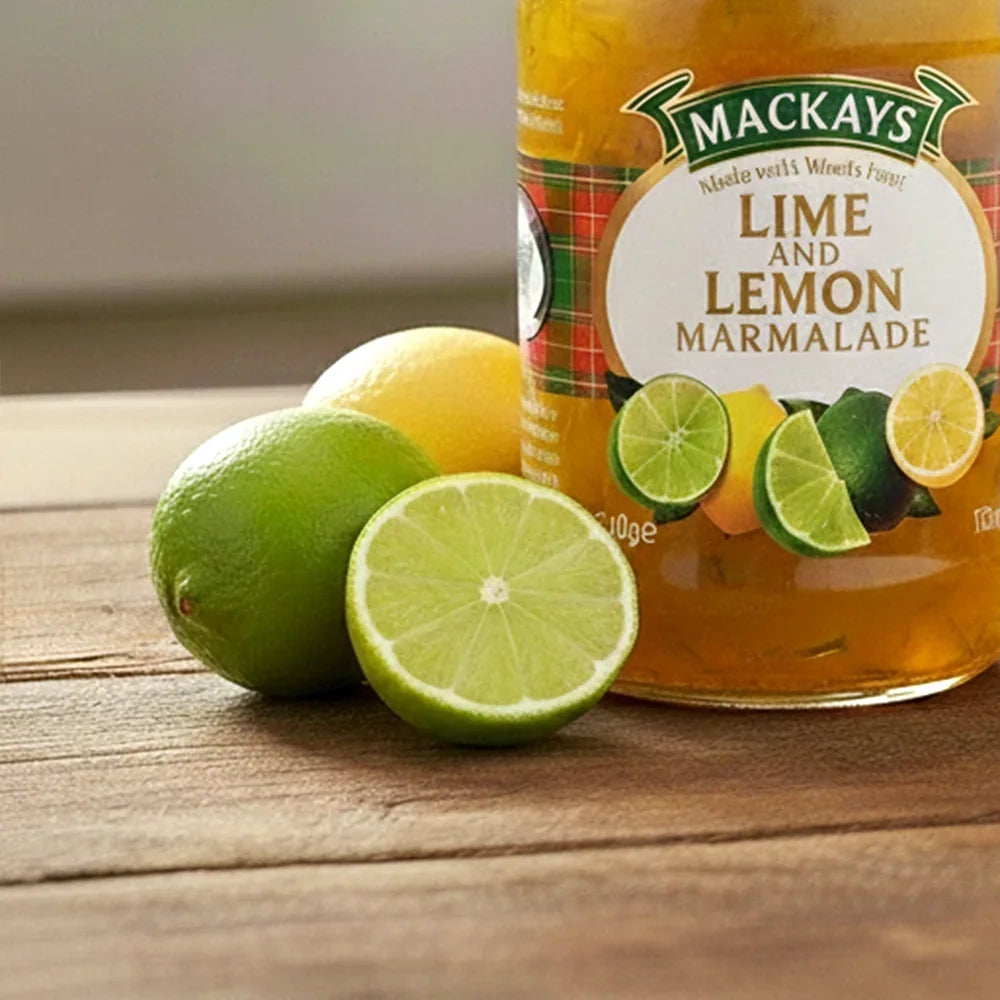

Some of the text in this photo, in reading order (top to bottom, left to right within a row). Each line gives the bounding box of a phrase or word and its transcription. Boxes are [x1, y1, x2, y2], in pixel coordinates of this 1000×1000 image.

[690, 91, 917, 151] MACKAYS
[739, 193, 872, 238] LIME
[768, 242, 840, 266] AND
[705, 268, 904, 315] LEMON
[676, 318, 930, 352] MARMALADE
